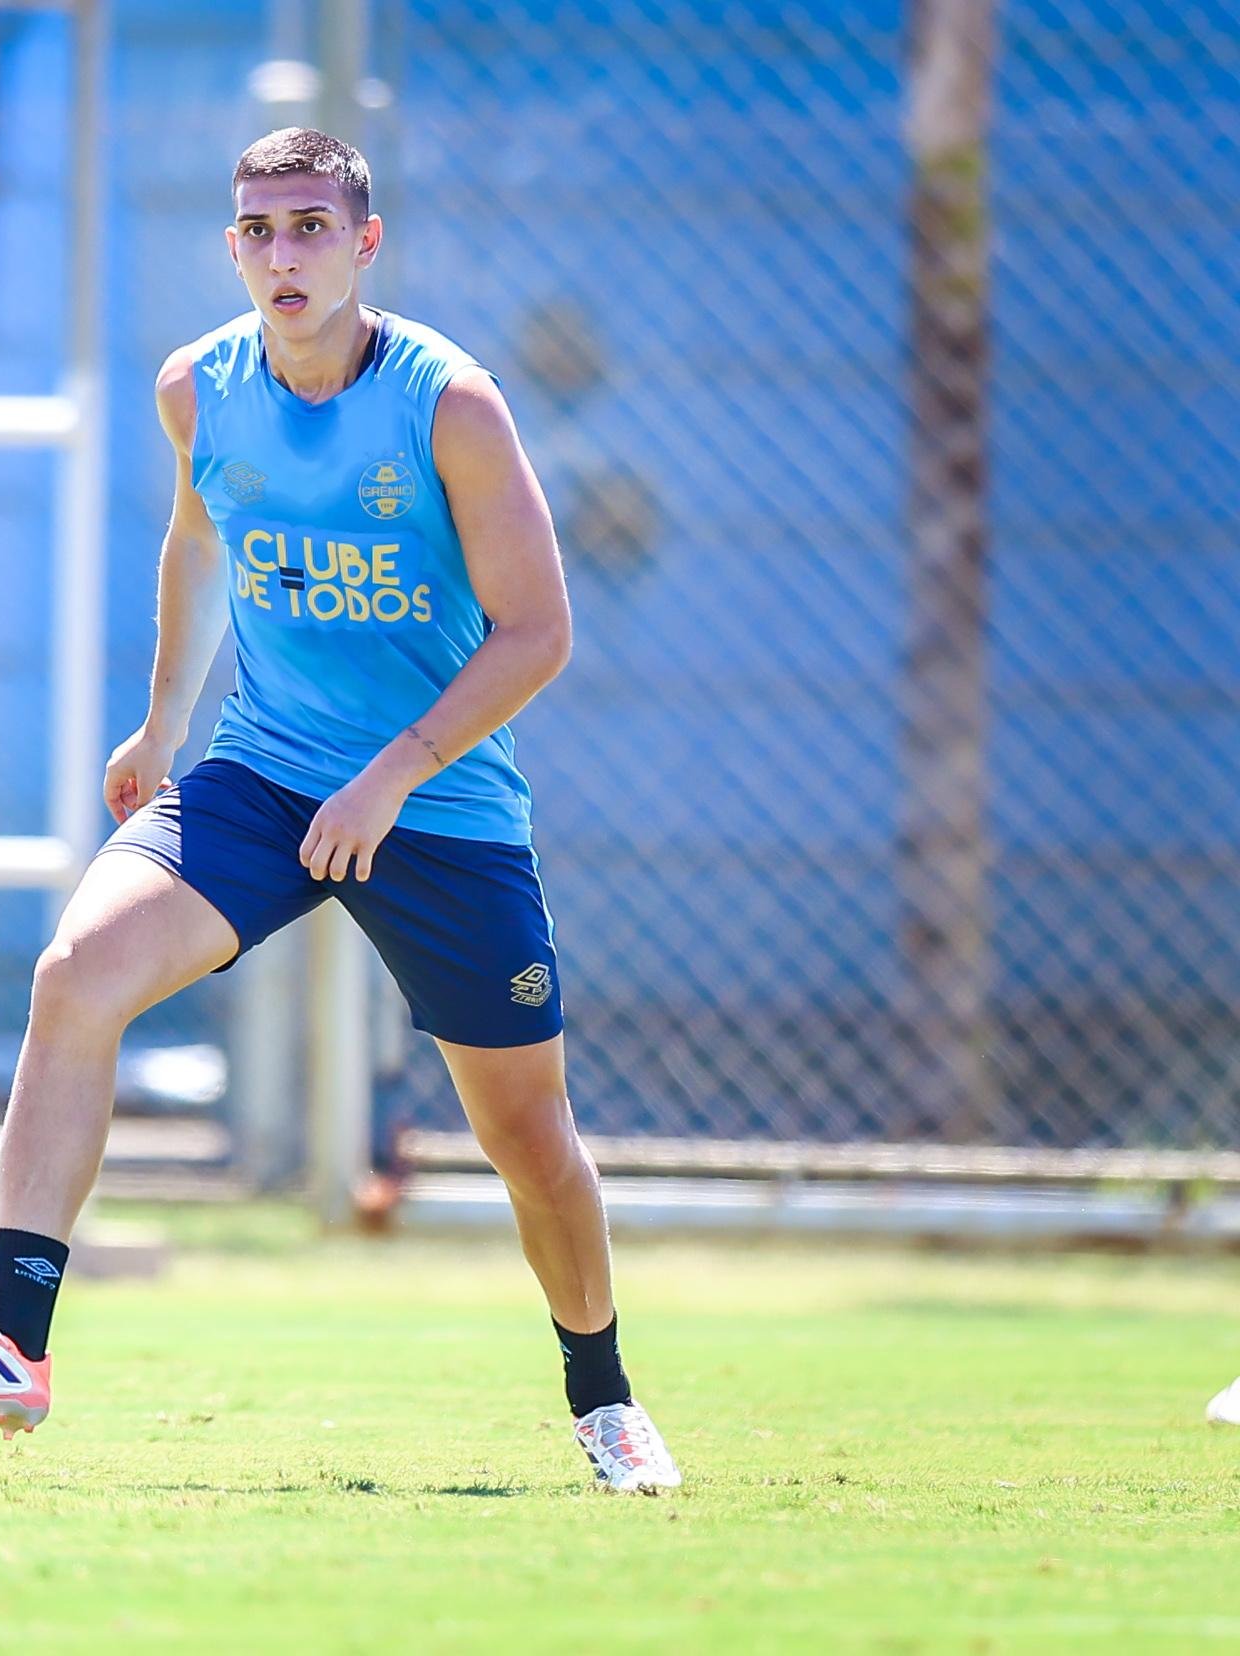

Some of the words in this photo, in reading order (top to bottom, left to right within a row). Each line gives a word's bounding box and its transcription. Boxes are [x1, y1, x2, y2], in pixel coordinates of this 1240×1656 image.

[243, 529, 400, 587] CLUBE
[235, 560, 272, 611] DE
[280, 578, 432, 623] TODOS
